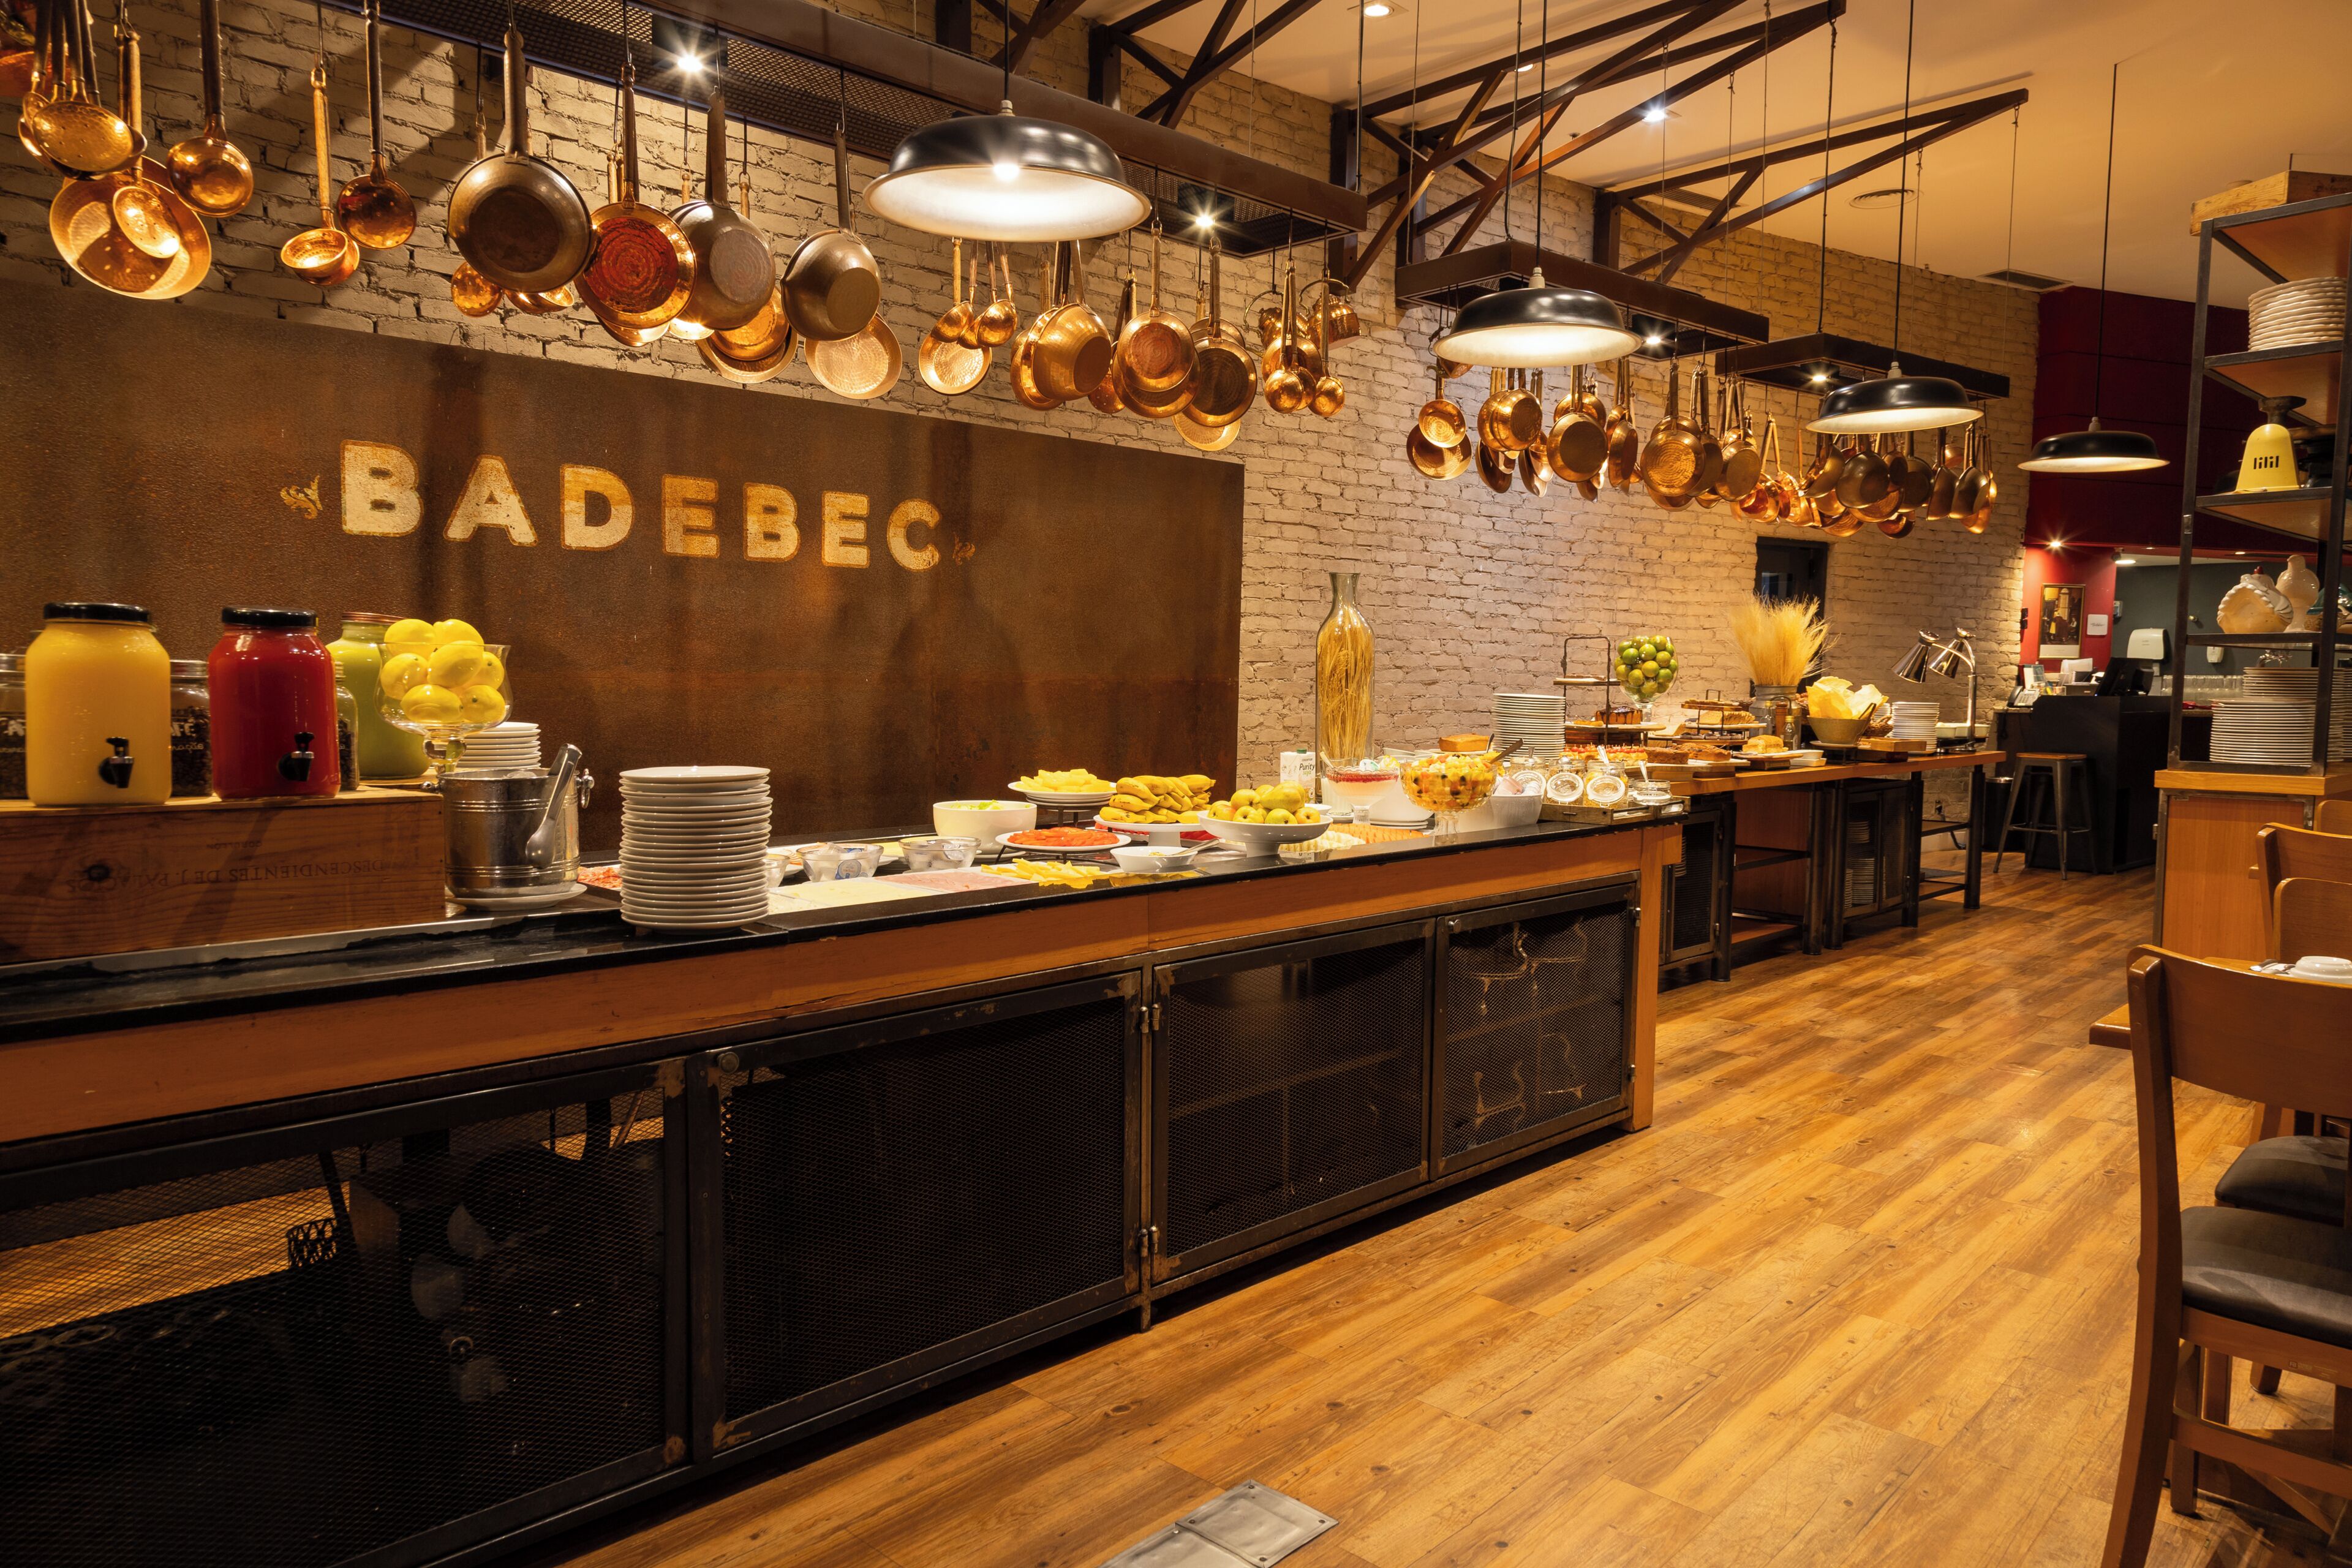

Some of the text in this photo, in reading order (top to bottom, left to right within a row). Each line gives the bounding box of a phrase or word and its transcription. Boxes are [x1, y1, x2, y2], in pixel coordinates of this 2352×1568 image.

[340, 439, 940, 571] BADEBEC
[175, 869, 190, 886] J.
[195, 869, 221, 886] DE
[228, 859, 384, 883] DESCENDIENTES
